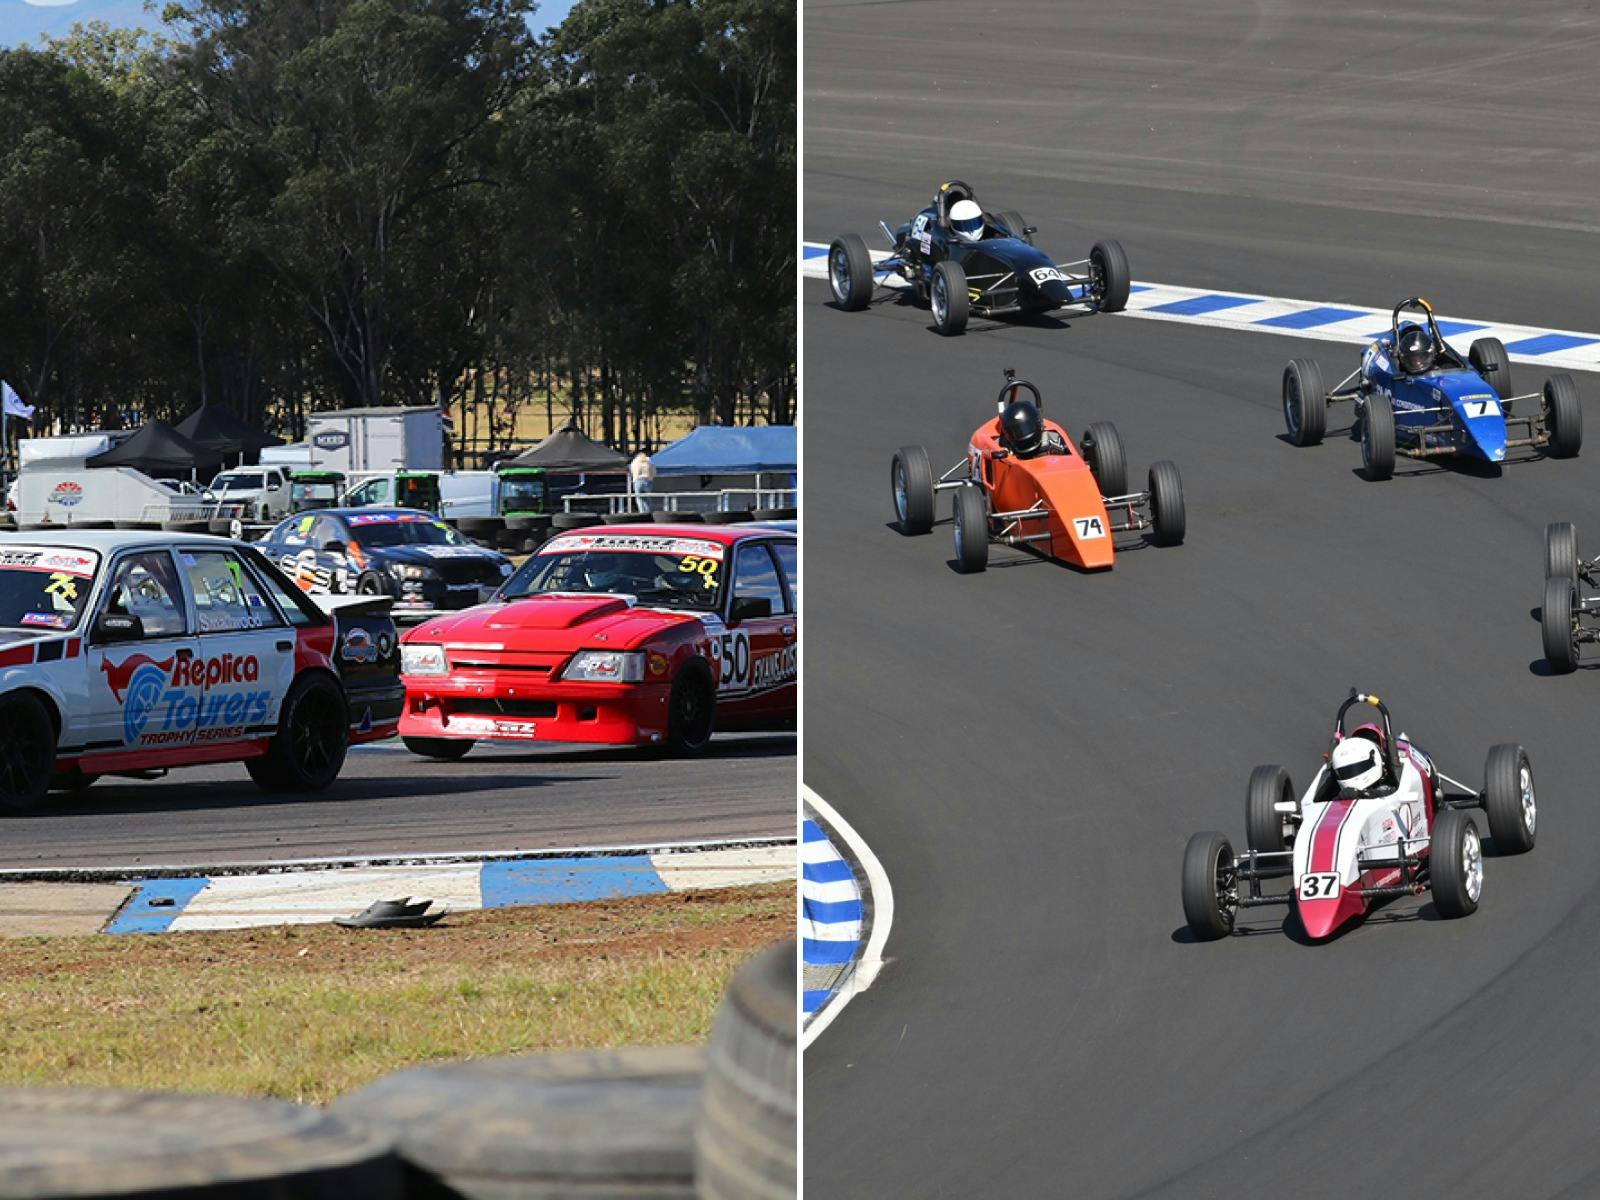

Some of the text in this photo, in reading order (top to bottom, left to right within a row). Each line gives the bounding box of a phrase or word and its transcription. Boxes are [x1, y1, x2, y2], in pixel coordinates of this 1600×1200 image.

[1033, 268, 1061, 282] 64
[1472, 401, 1488, 415] 7
[1076, 518, 1103, 537] 74
[679, 555, 719, 575] 50
[721, 632, 748, 684] 50
[171, 653, 259, 691] Replica
[160, 690, 272, 730] Tourers
[139, 726, 245, 745] TROPHY SERIES
[1303, 876, 1337, 898] 37
